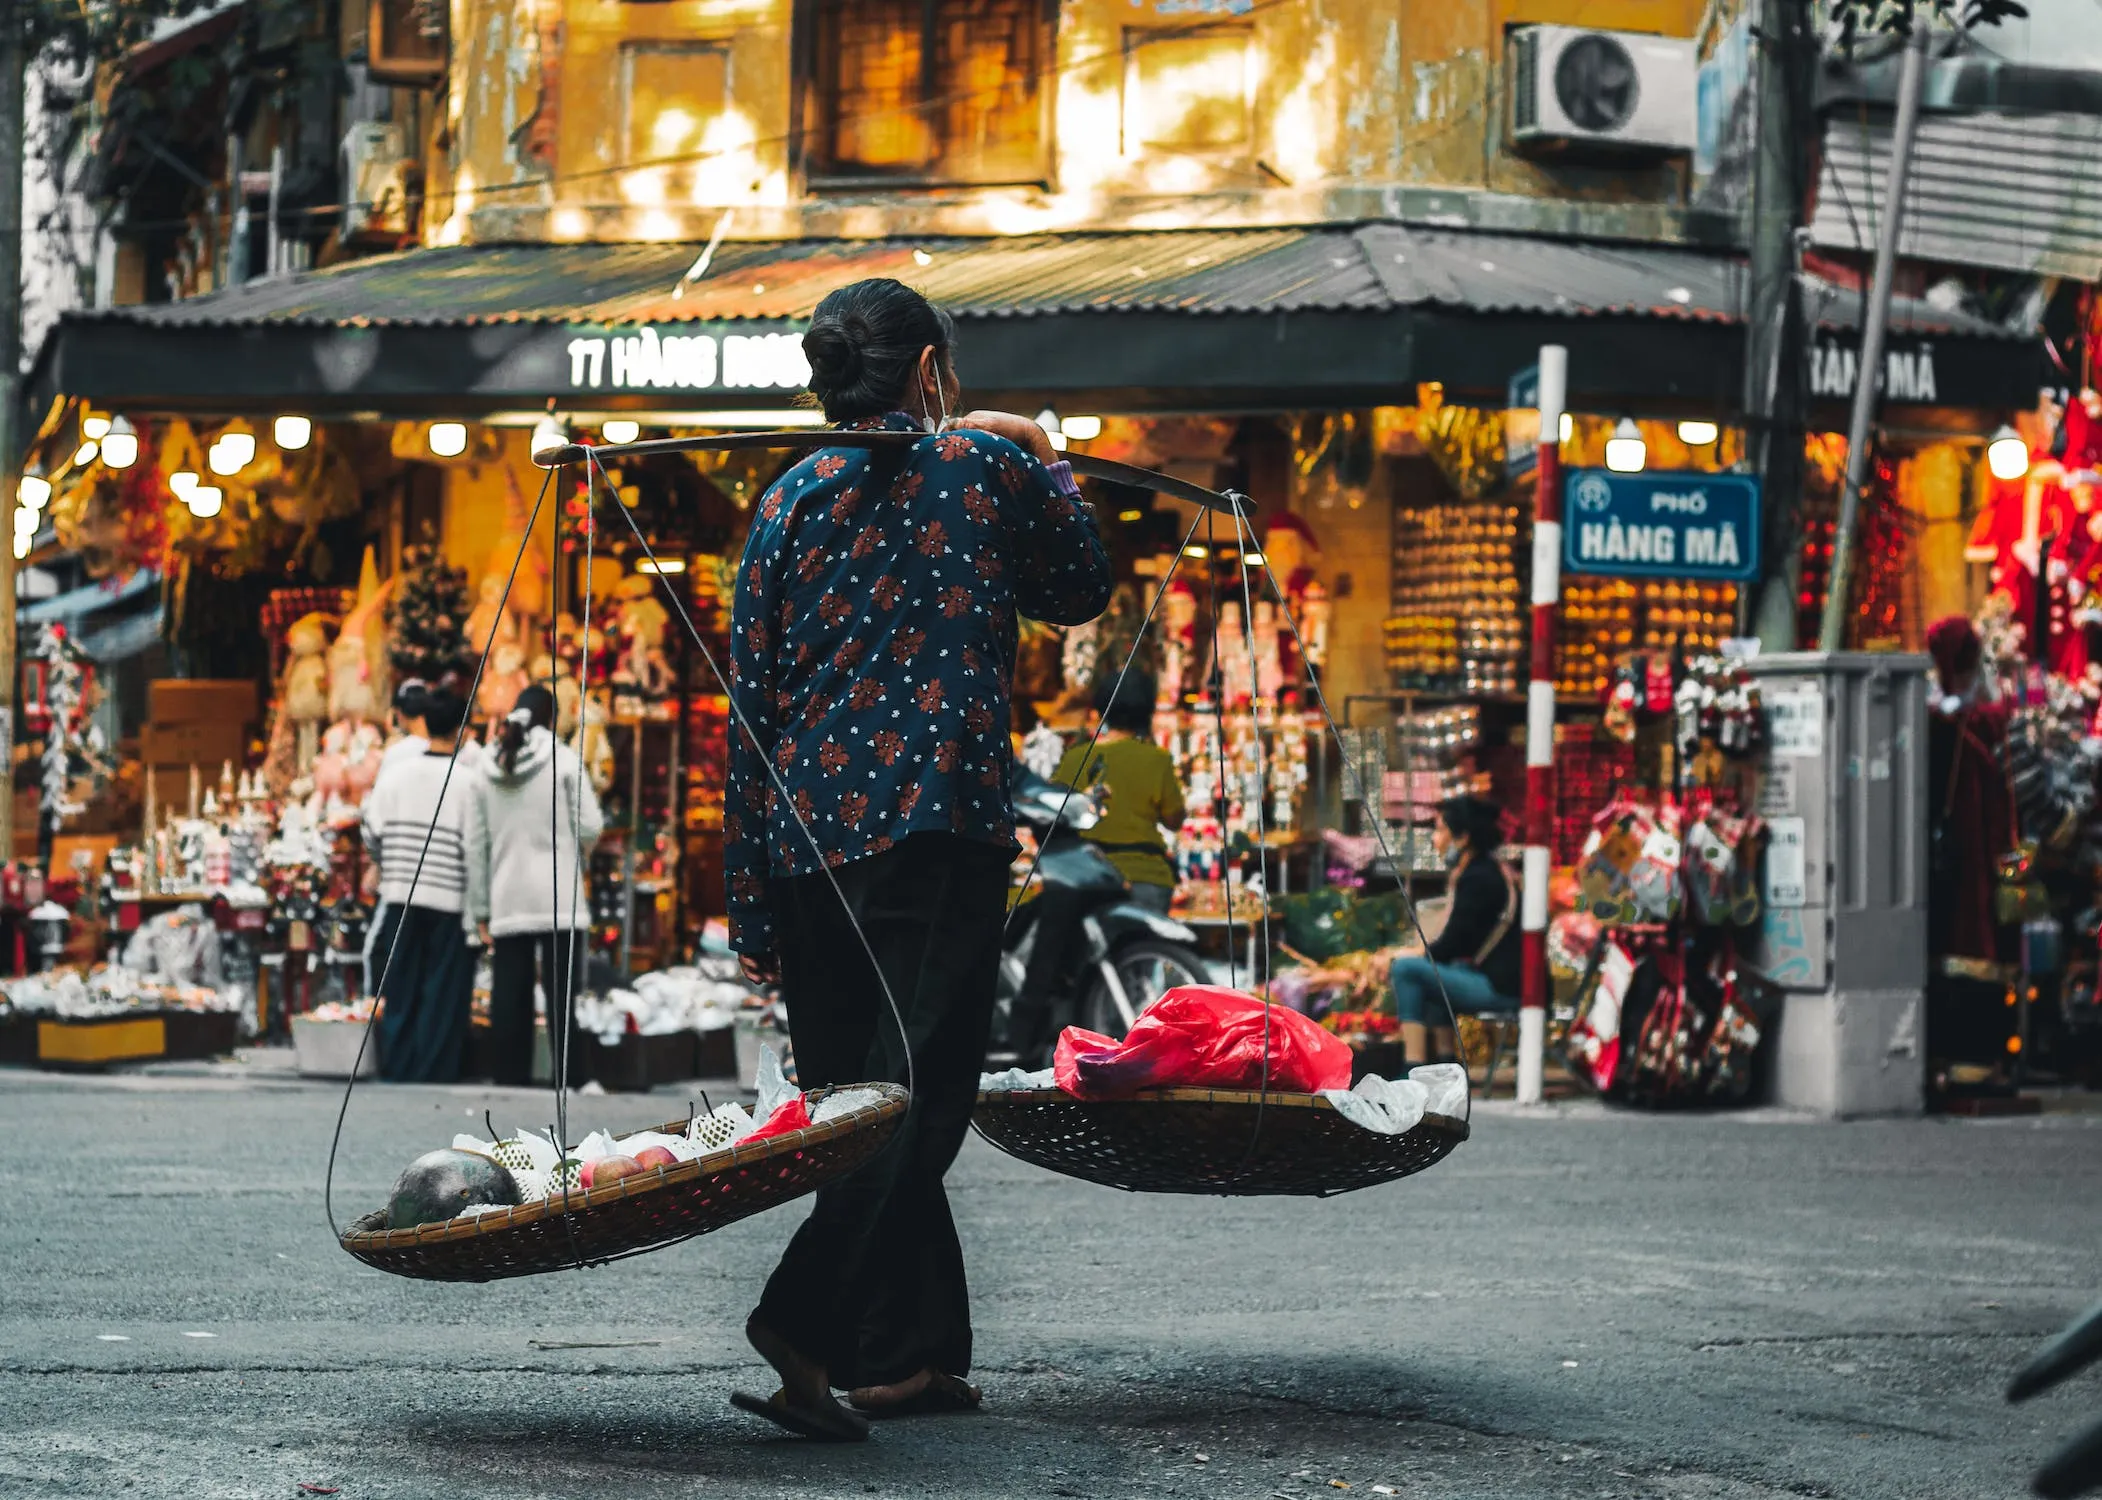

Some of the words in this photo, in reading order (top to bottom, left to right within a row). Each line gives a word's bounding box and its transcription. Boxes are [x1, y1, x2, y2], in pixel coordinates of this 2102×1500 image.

[568, 337, 606, 388] 17
[1580, 515, 1676, 562] HÀNG
[1685, 521, 1740, 565] MÃ
